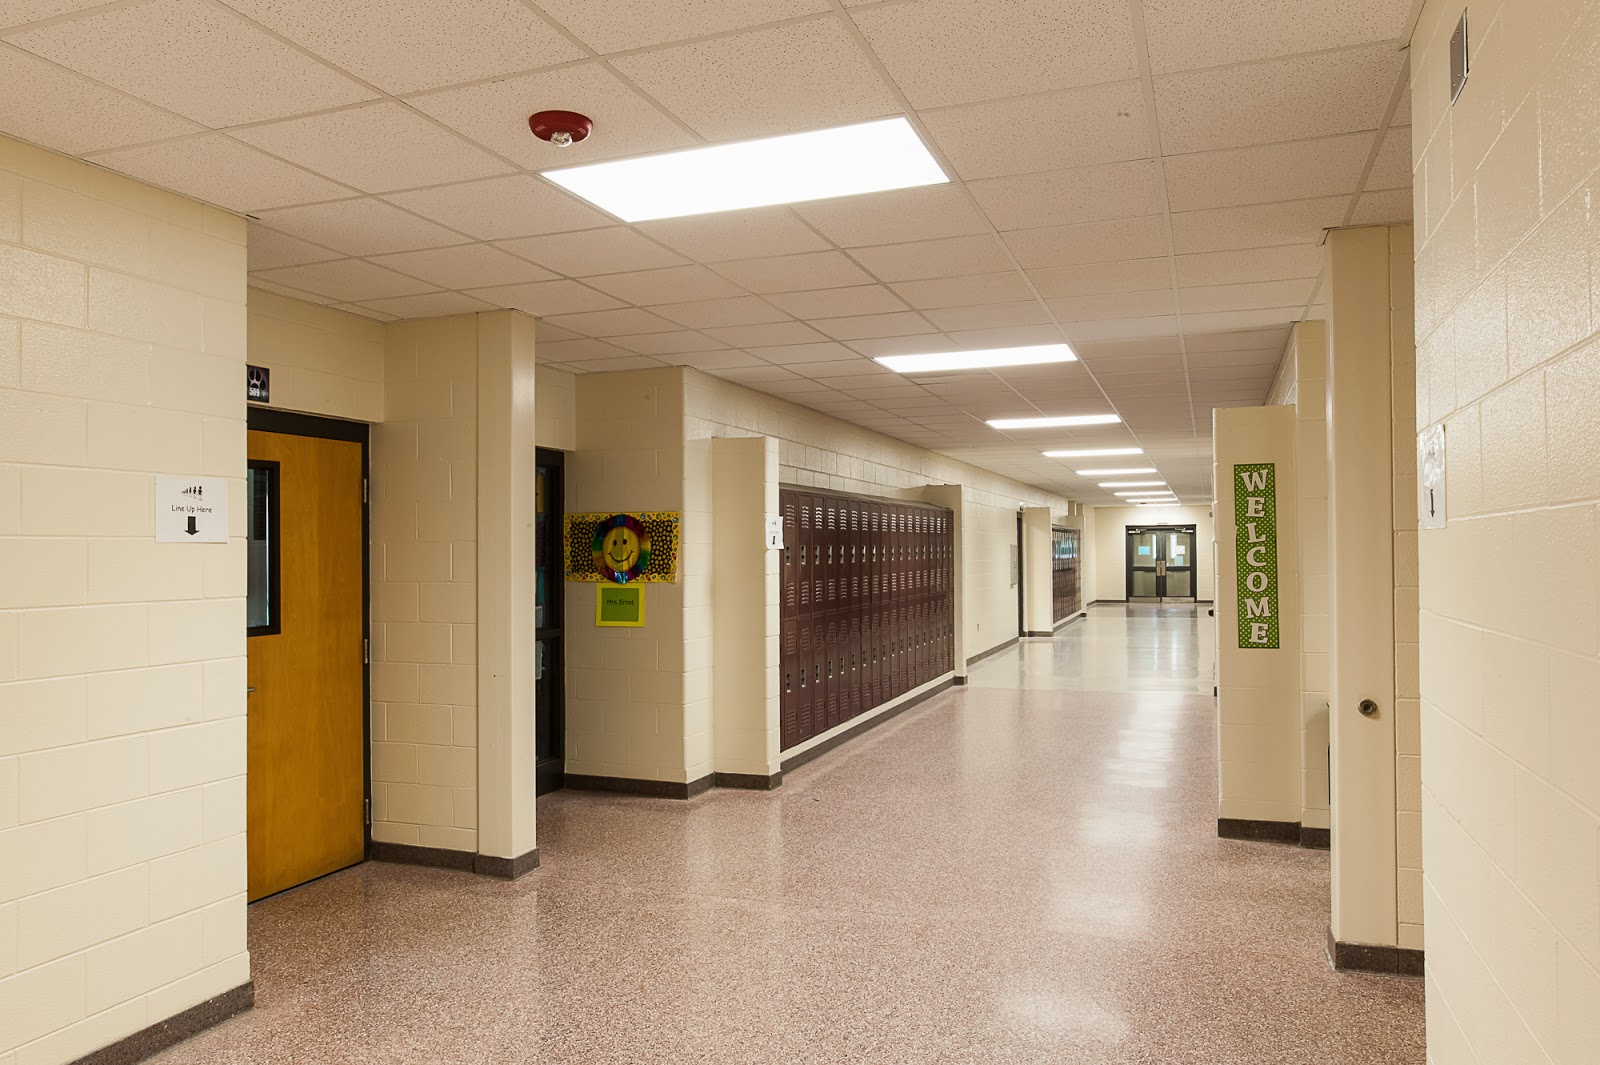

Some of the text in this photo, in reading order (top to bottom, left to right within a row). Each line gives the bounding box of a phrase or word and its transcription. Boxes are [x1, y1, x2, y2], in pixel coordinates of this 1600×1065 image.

[171, 504, 213, 514] Line Up Here
[1240, 469, 1272, 644] WELCOME
